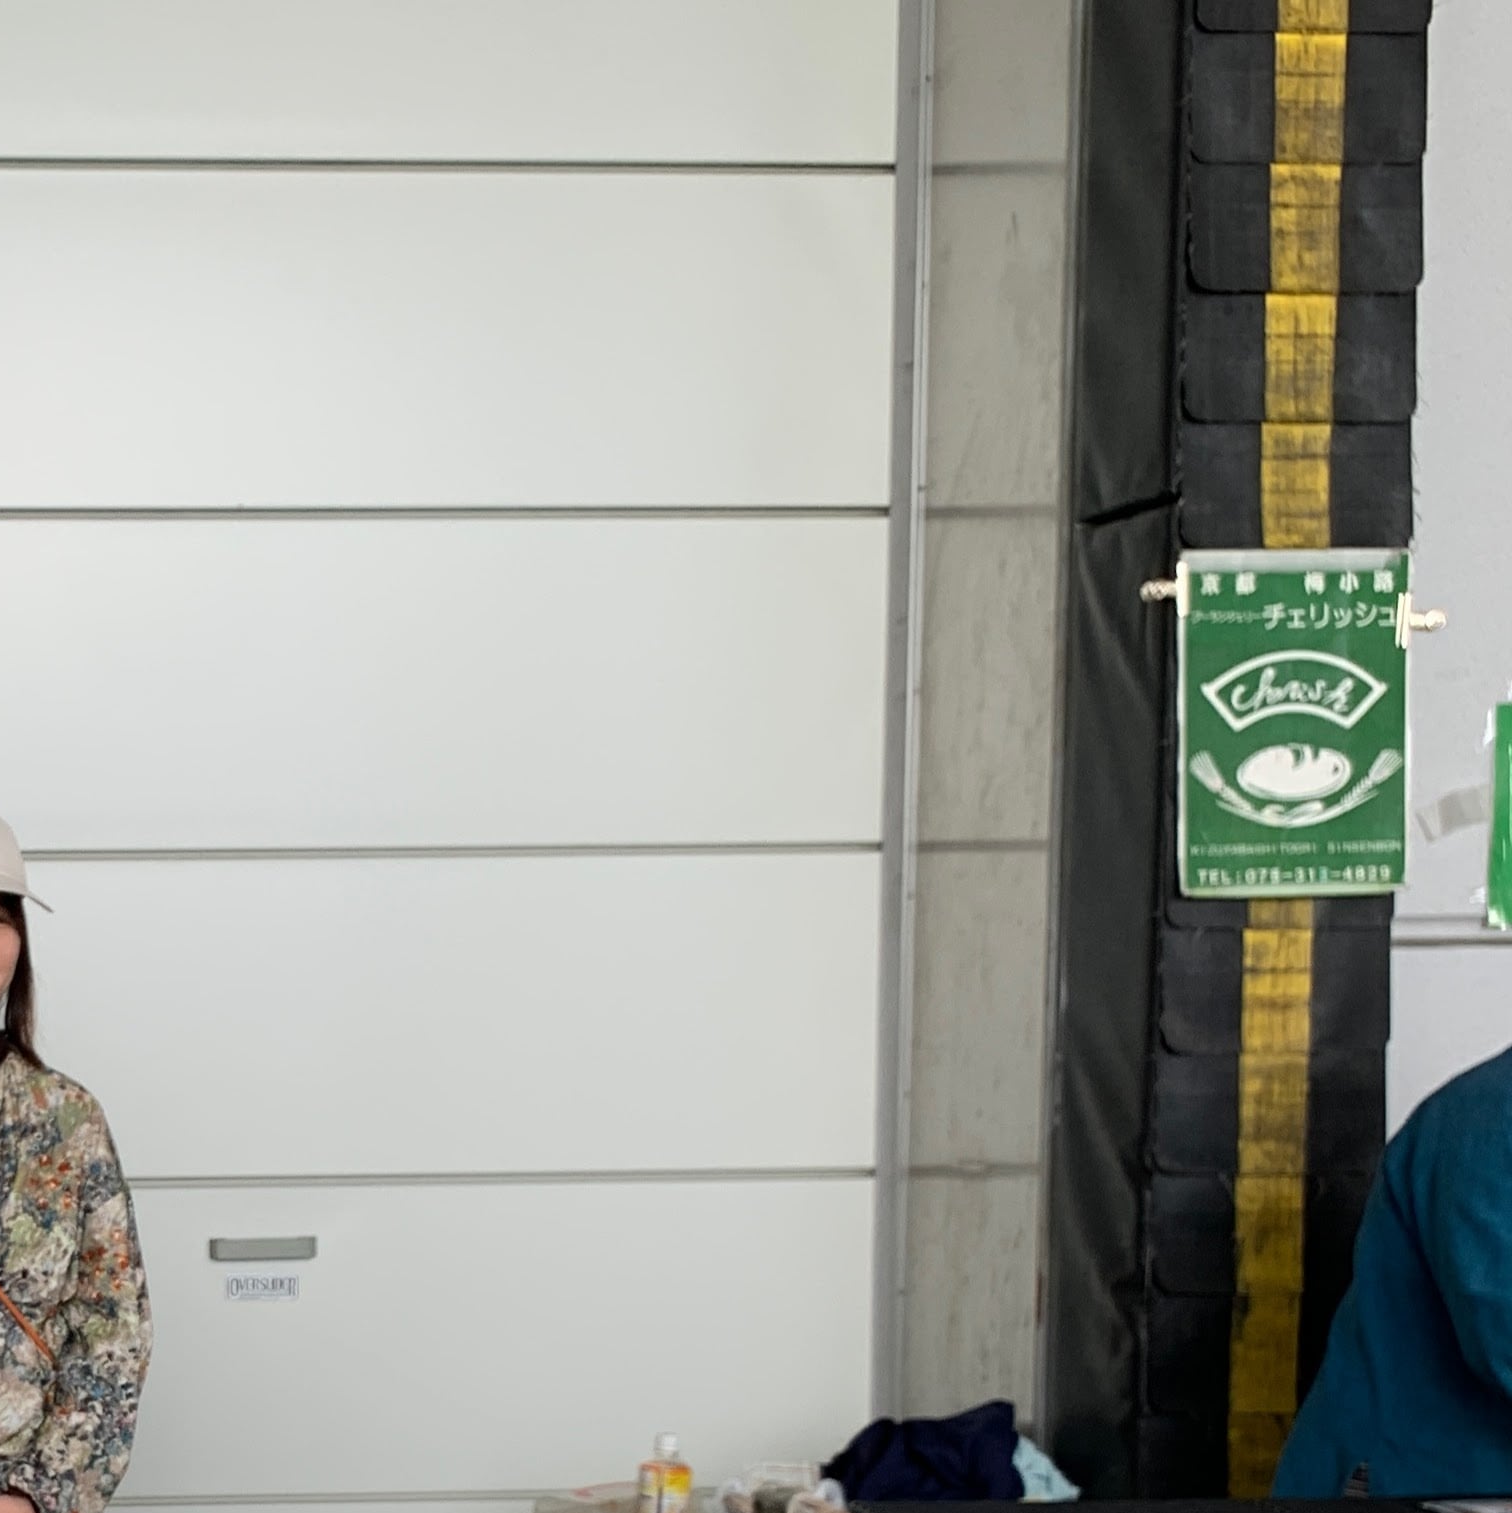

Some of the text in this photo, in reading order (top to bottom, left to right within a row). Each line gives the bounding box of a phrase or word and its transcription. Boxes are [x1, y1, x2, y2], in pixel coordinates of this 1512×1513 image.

[1262, 601, 1396, 631] チェリッシュ
